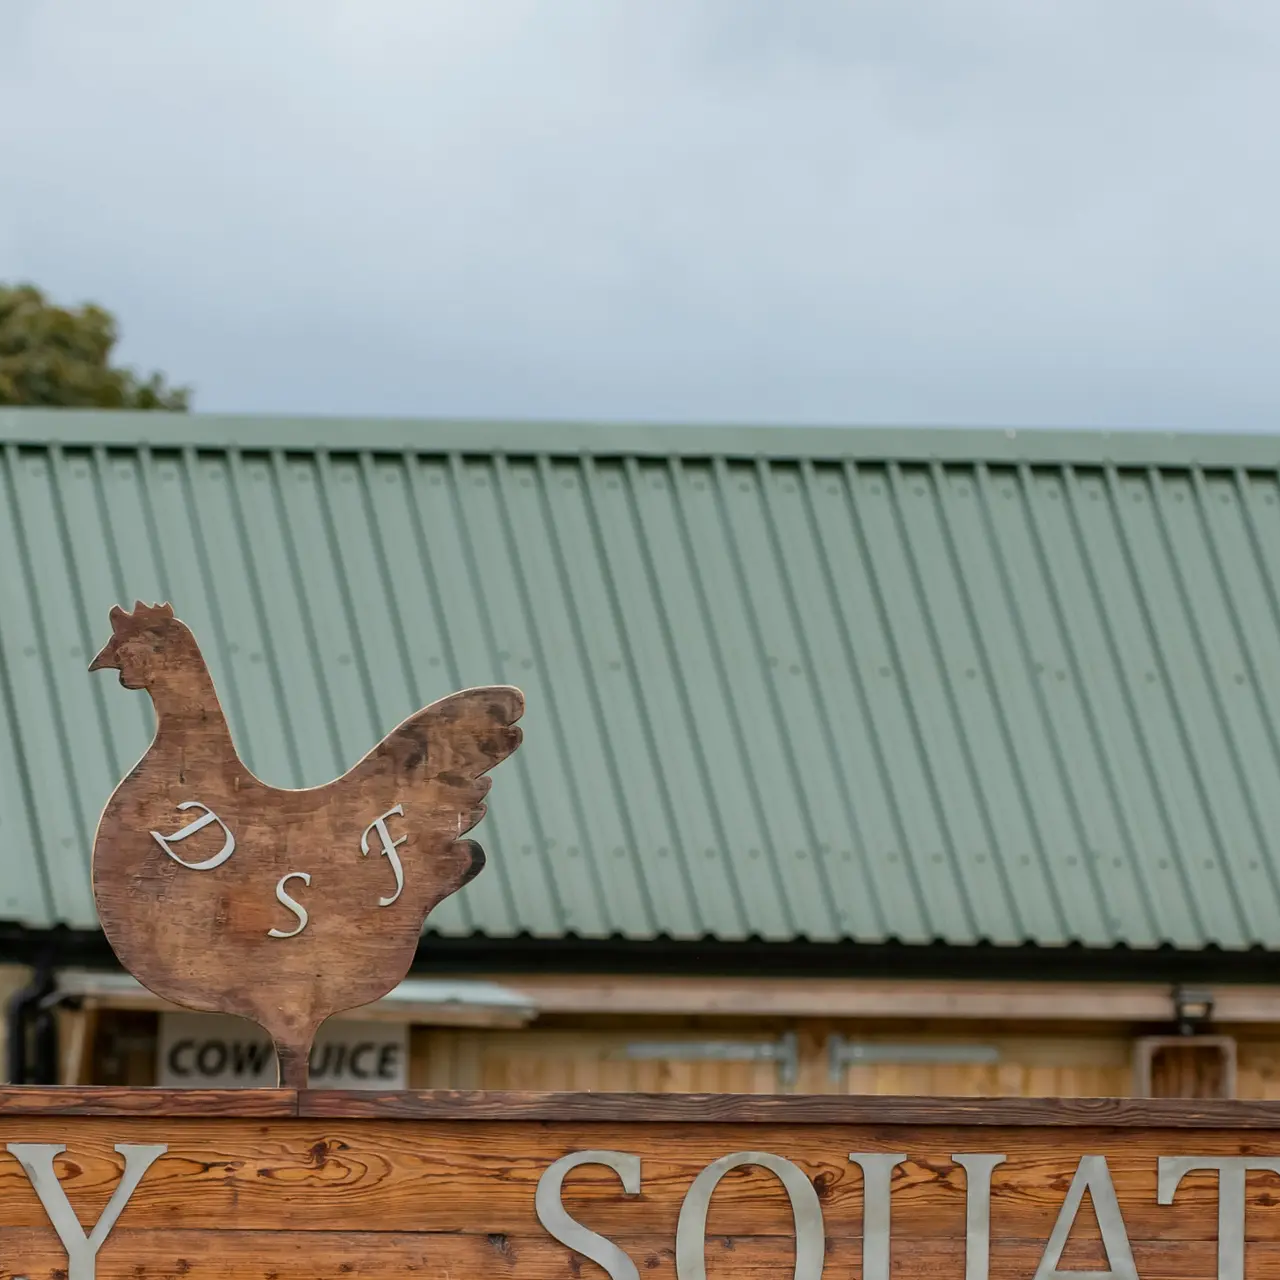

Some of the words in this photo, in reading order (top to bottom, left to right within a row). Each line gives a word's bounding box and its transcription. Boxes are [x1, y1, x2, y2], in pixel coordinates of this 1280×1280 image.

[149, 800, 236, 871] D
[267, 871, 312, 938] S
[360, 803, 408, 907] F
[168, 1039, 272, 1079] COW
[307, 1041, 400, 1080] UICE
